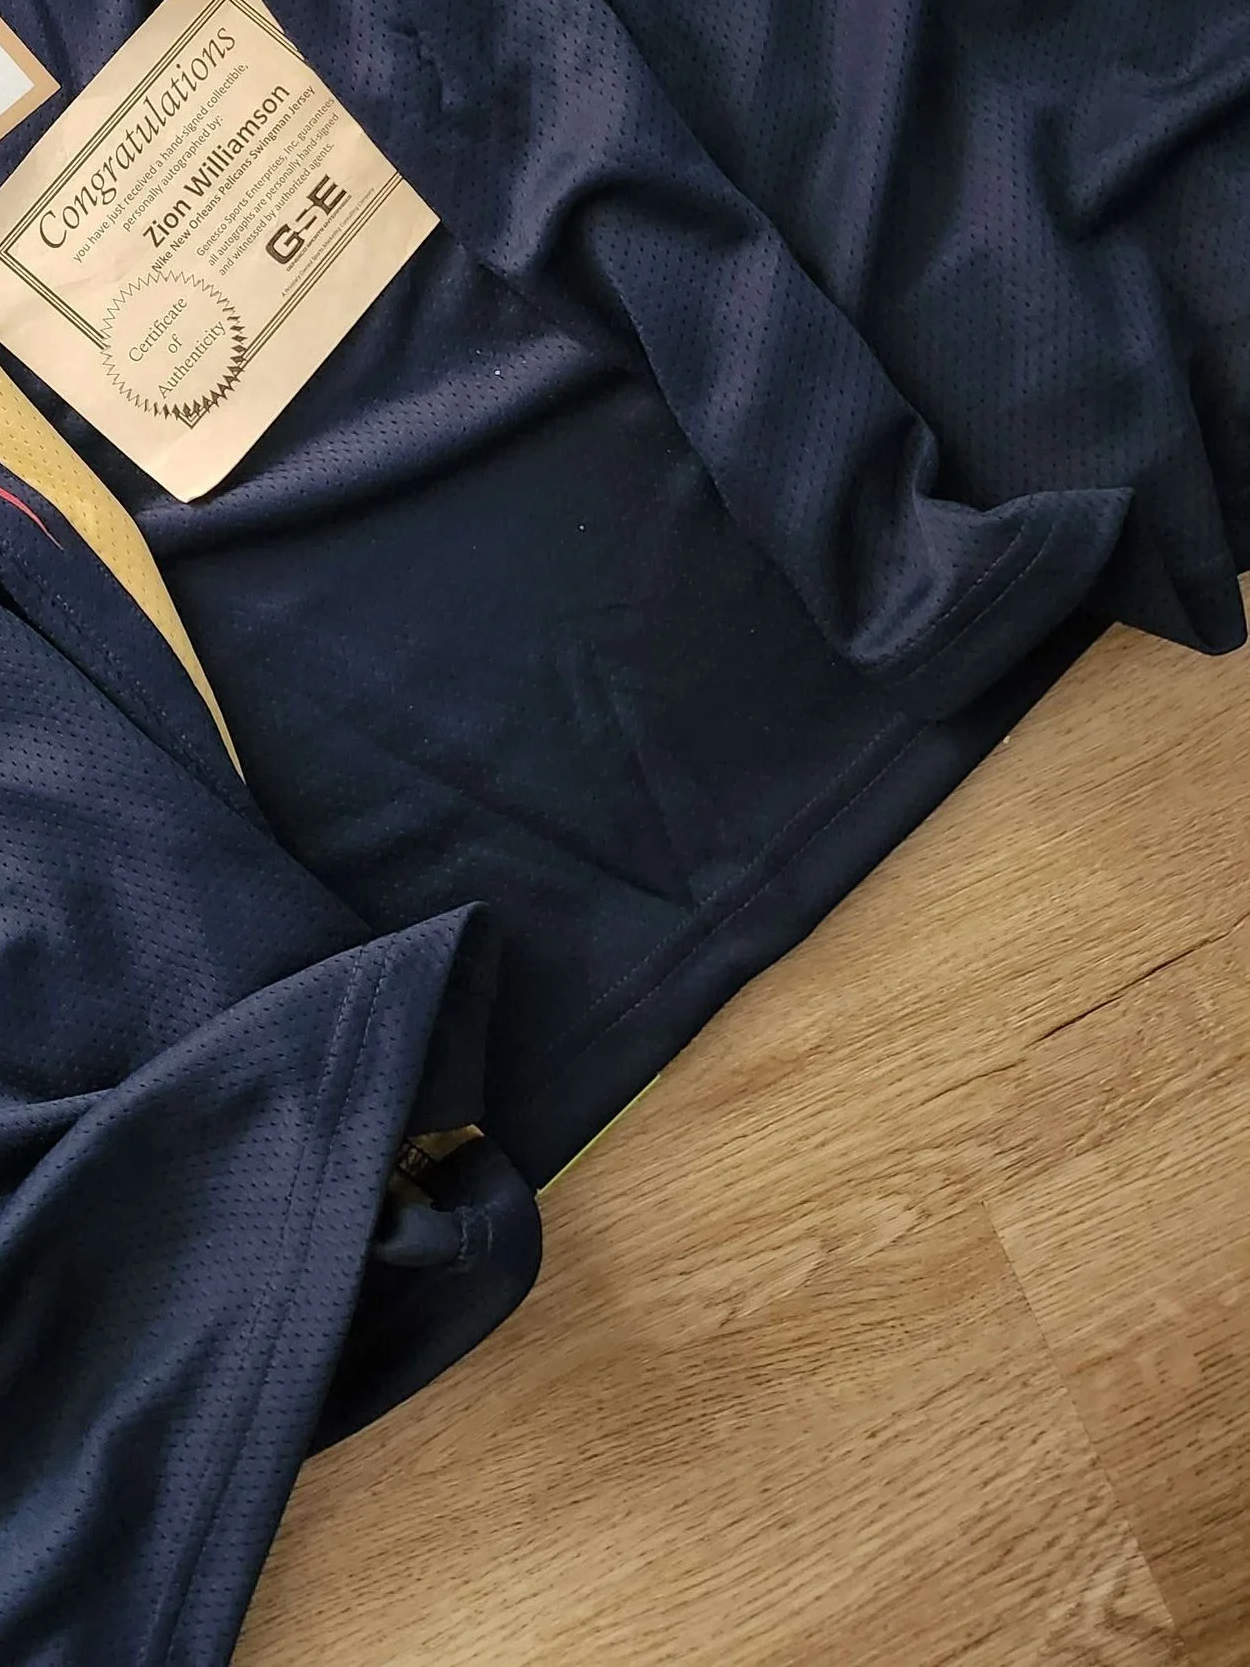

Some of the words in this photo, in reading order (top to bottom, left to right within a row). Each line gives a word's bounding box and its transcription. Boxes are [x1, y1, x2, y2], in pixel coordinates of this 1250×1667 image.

[39, 27, 236, 249] Congratulations
[73, 243, 91, 264] you
[86, 221, 111, 245] have
[106, 203, 126, 225] just
[123, 164, 158, 206] received
[159, 105, 209, 161] hand-signed
[206, 64, 249, 108] collectible,
[122, 183, 164, 233] personally
[160, 127, 211, 186] autographed
[205, 115, 224, 131] by:
[142, 199, 192, 248] Zion
[183, 85, 291, 197] Williamson
[151, 251, 174, 275] Nike
[169, 228, 191, 252] New
[188, 194, 222, 230] Orleans
[217, 158, 253, 196] Pelicans
[248, 113, 292, 160] Swingman
[288, 85, 316, 115] Jersey
[196, 223, 228, 257] Genesco
[223, 198, 249, 225] Sports
[245, 155, 288, 200] Enterprises,
[283, 140, 300, 155] Inc.
[297, 97, 335, 142] guarantees
[208, 253, 220, 267] all
[217, 211, 256, 256] autographs
[253, 198, 268, 214] are
[265, 158, 302, 201] personally
[296, 112, 340, 161] hand-signed
[218, 257, 235, 276] and
[231, 218, 268, 260] witnessed
[262, 209, 277, 222] by
[273, 167, 311, 212] authorized
[308, 143, 335, 171] agents.
[128, 298, 188, 362] Certificate
[158, 321, 226, 400] Authenticity
[167, 333, 183, 354] of
